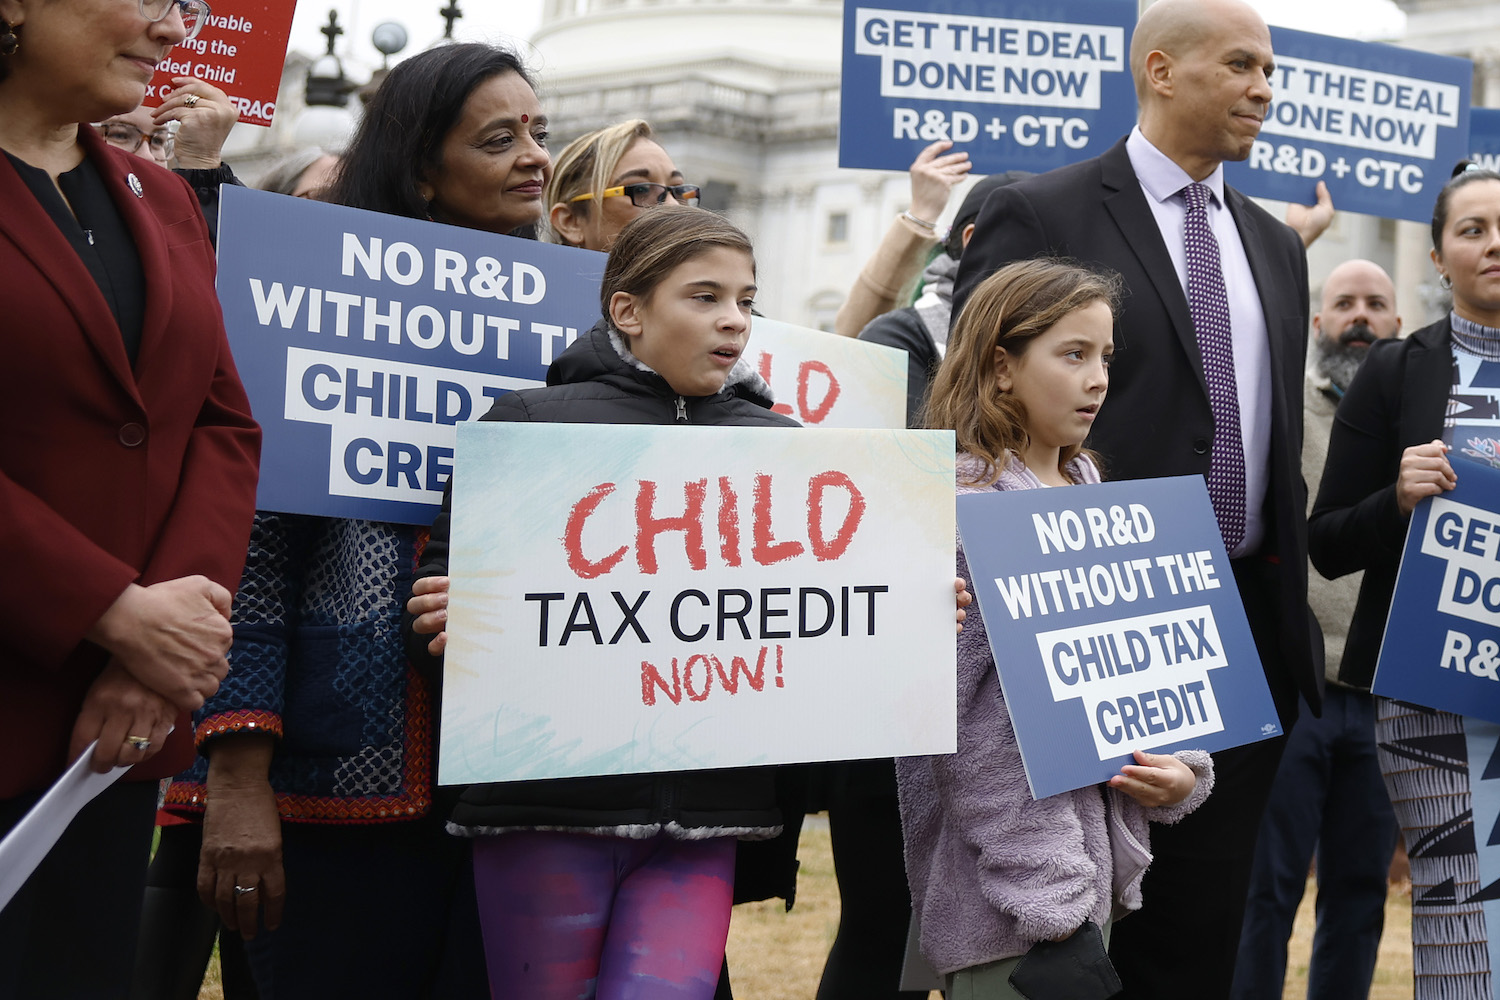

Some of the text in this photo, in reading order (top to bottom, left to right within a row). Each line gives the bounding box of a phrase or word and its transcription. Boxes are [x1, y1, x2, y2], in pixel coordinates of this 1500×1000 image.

[210, 39, 238, 57] the
[864, 18, 1117, 62] GET THE DEAL
[193, 63, 236, 83] Child
[892, 59, 1089, 98] DONE NOW
[1303, 68, 1367, 103] THE
[1373, 80, 1451, 118] DEAL
[893, 107, 1089, 150] R&D + CTC
[1350, 112, 1426, 148] NOW
[1249, 139, 1425, 195] R&D + CTC
[342, 232, 546, 305] NO R&D
[249, 278, 520, 360] WITHOUT
[301, 363, 472, 426] CHILD
[558, 470, 867, 580] CHILD
[1031, 503, 1156, 555] NO R&D
[994, 550, 1221, 620] WITHOUT THE
[524, 585, 889, 647] TAX CREDIT
[640, 644, 784, 706] NOW!
[1051, 617, 1218, 686] CHILD TAX
[1096, 680, 1209, 745] CREDIT
